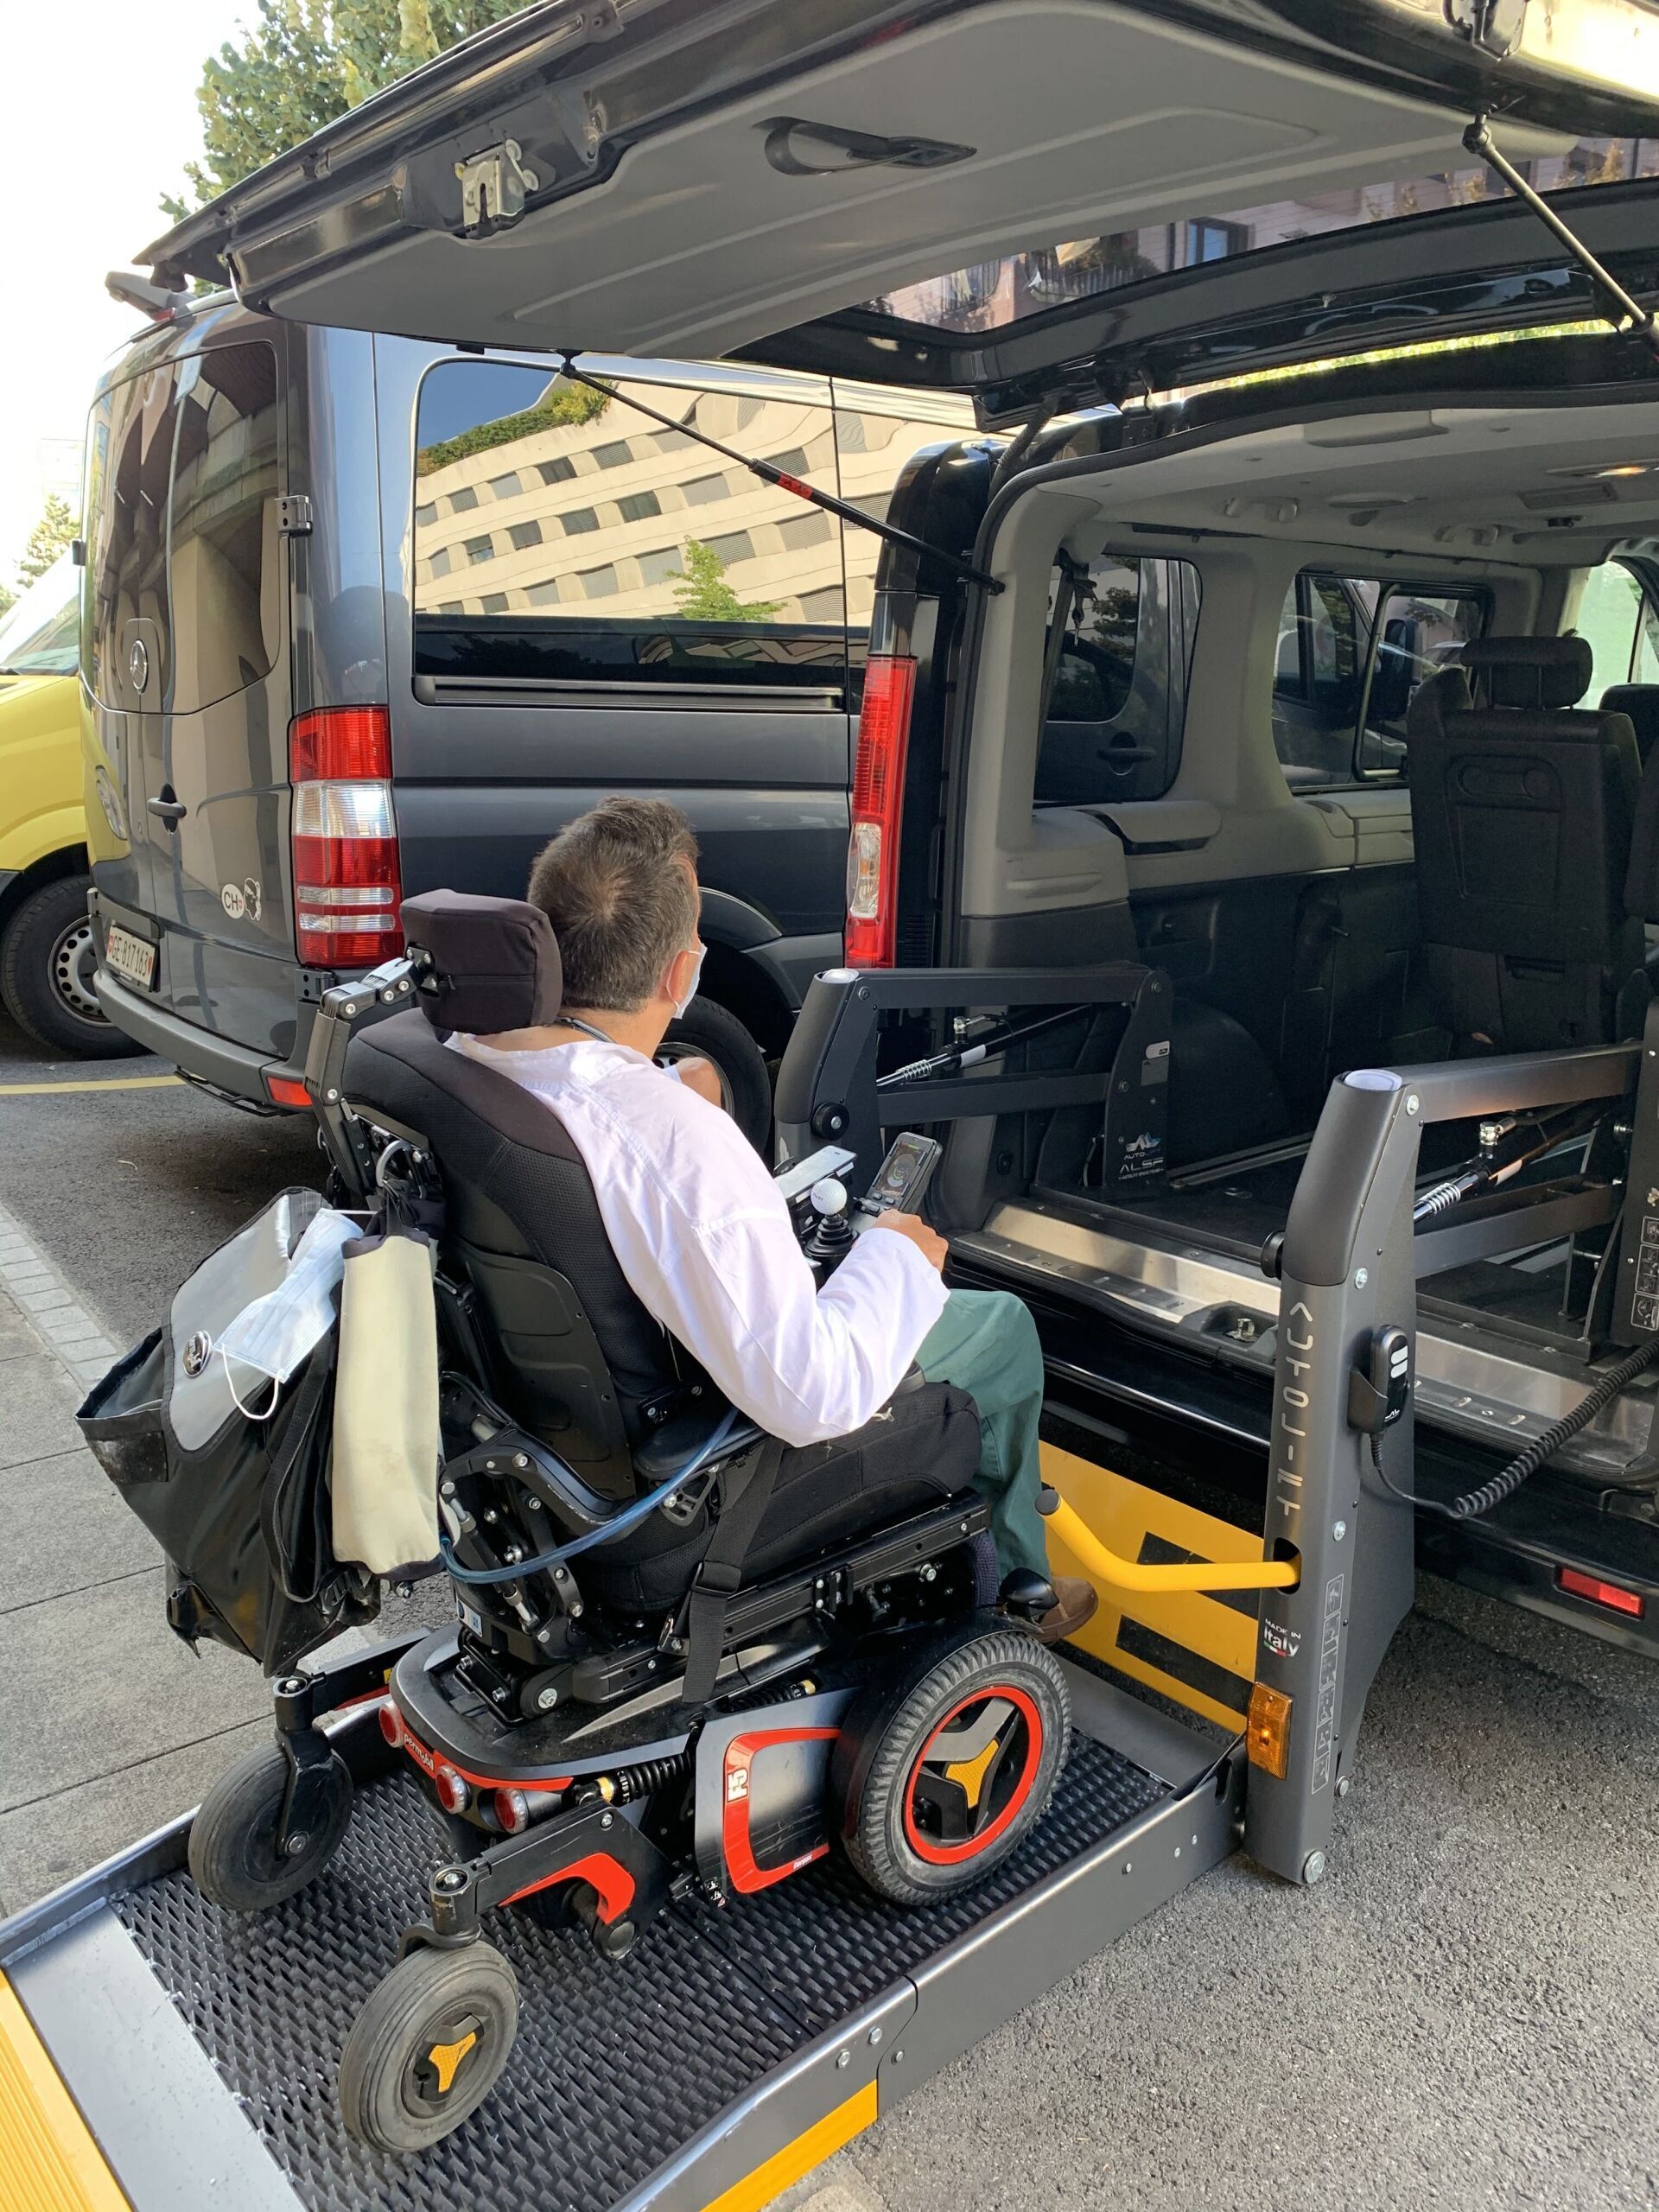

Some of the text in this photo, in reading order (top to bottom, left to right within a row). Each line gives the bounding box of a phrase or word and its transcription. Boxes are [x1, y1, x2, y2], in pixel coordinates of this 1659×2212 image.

[225, 892, 238, 912] CH
[1264, 1625, 1300, 1657] Italy
[1265, 1618, 1288, 1636] MADE
[404, 1732, 434, 1771] permobil
[727, 1768, 748, 1802] F5
